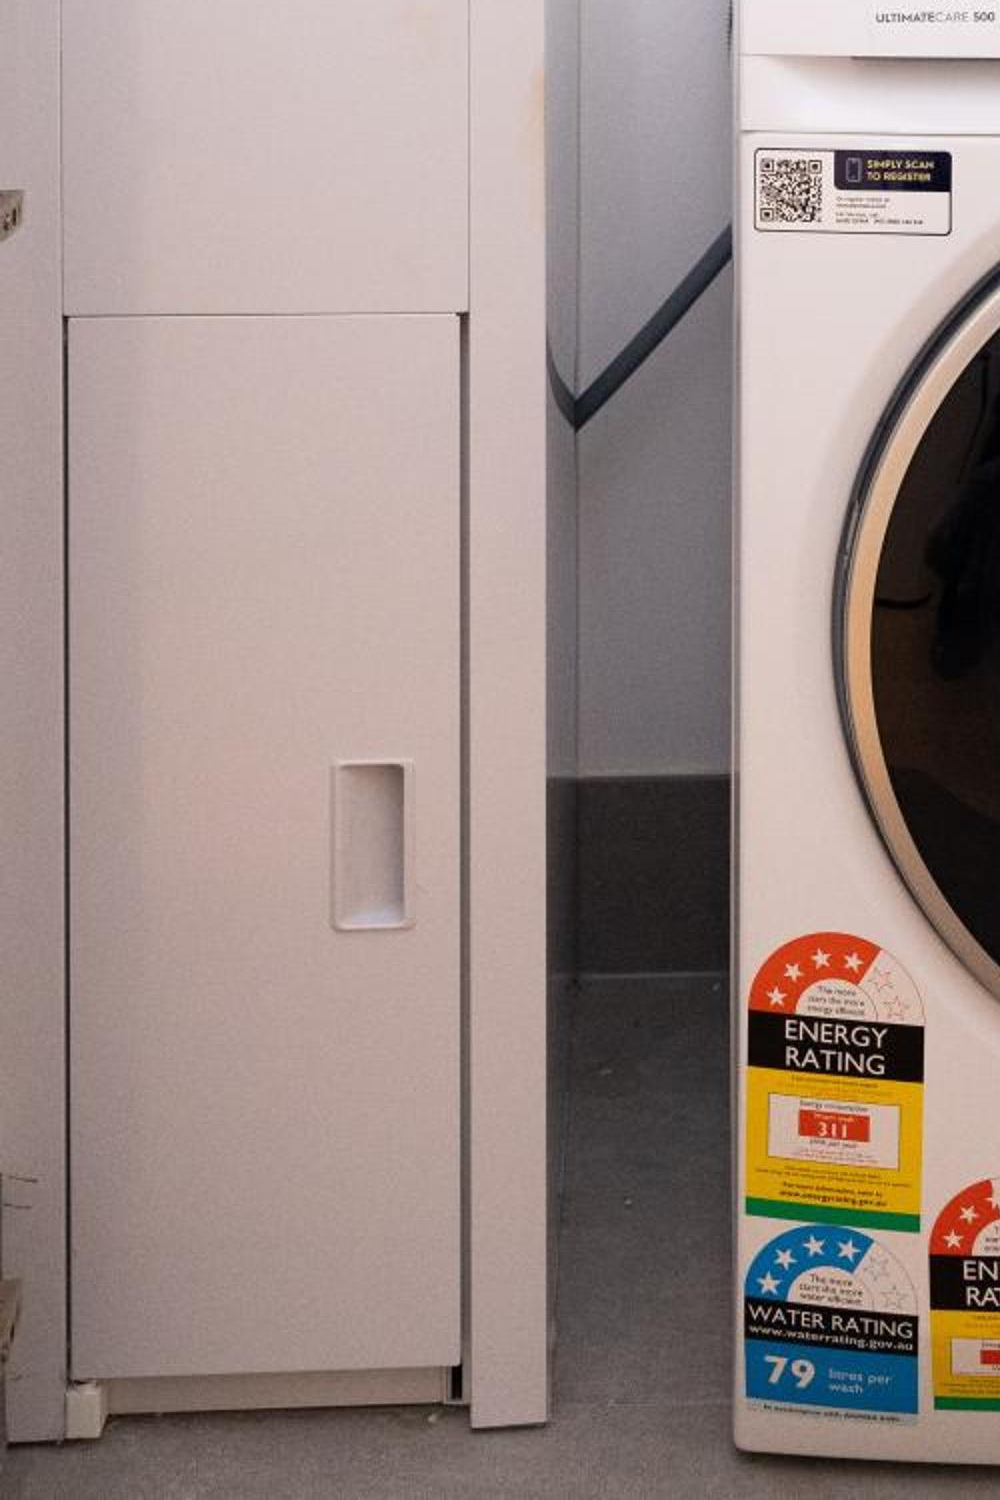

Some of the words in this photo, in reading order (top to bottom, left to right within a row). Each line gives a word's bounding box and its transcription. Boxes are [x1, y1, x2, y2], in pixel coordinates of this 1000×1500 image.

[876, 12, 969, 23] ULTIMATECARE
[973, 12, 995, 22] 500
[867, 159, 901, 169] SIMPLY
[904, 160, 935, 169] SCAN
[866, 172, 881, 181] TO
[883, 172, 931, 182] REGISTER
[785, 1019, 888, 1049] ENERGY
[785, 1047, 886, 1075] RATING
[818, 1121, 849, 1138] 311
[748, 1303, 825, 1330] WATER
[831, 1315, 913, 1339] RATING
[748, 1325, 913, 1351] www.waterrating.gov.au
[764, 1355, 816, 1389] 79
[868, 1374, 892, 1385] per
[829, 1383, 864, 1394] wash
